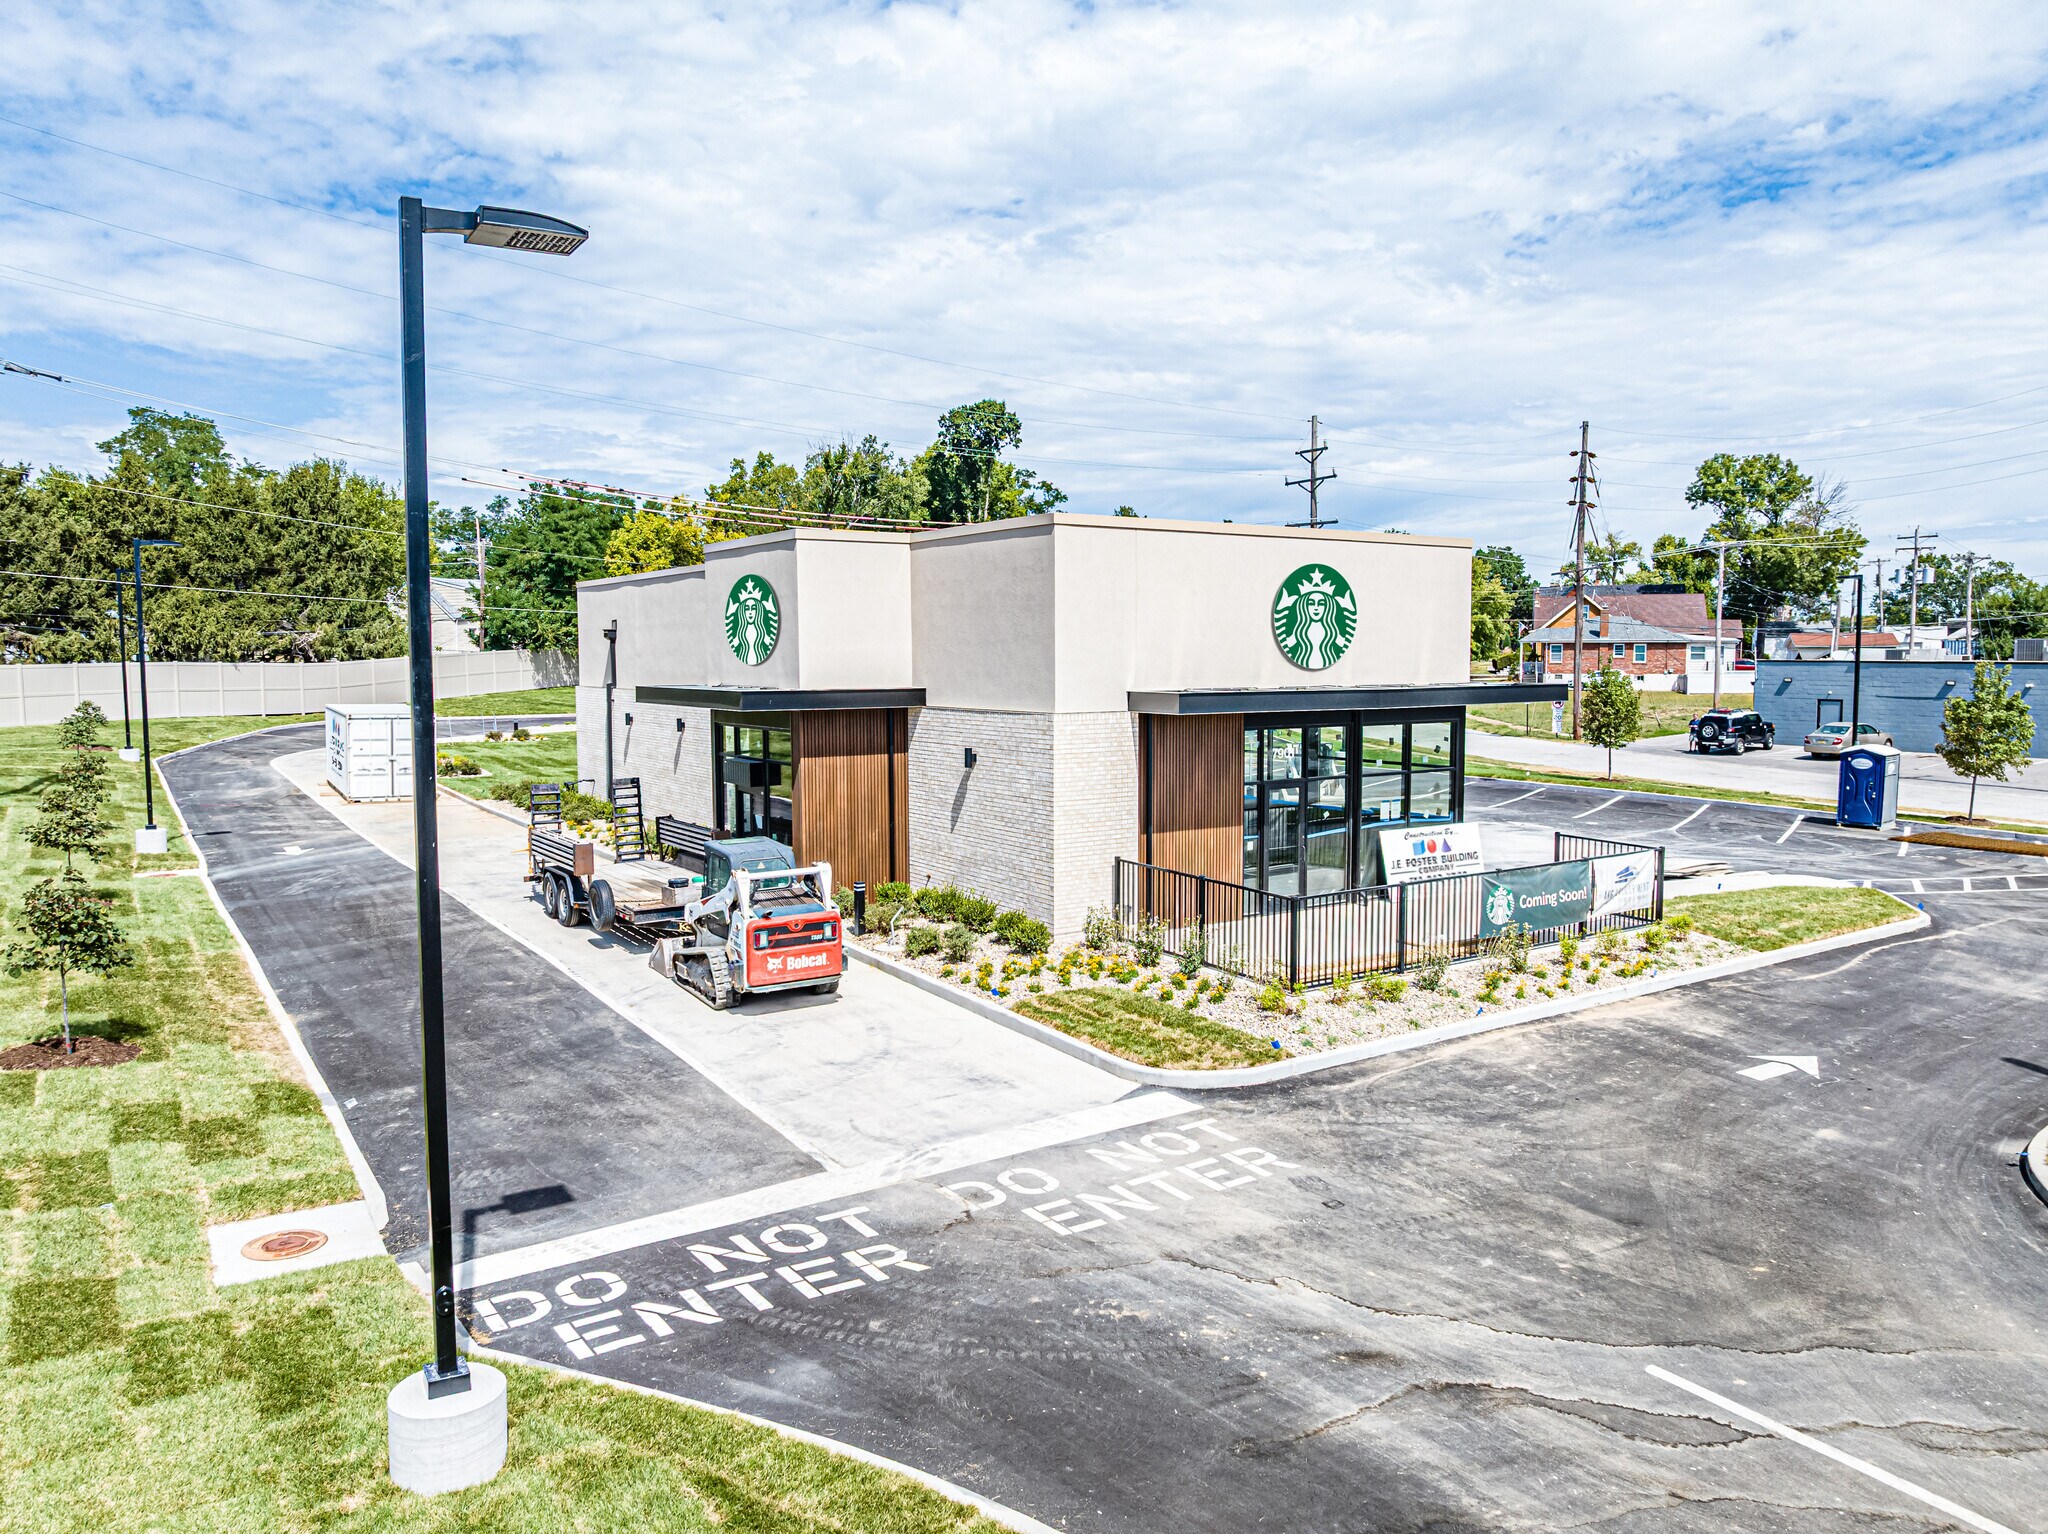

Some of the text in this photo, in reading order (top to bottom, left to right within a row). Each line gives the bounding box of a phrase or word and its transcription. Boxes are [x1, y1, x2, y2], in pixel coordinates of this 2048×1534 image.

[1404, 829, 1443, 840] Construction
[1406, 856, 1438, 867] FOSTER
[1441, 851, 1479, 863] BUILDING
[1418, 863, 1455, 874] COMPANY
[1519, 891, 1558, 909] Coming
[1558, 886, 1588, 903] Soon!
[786, 952, 828, 970] Bobcat
[937, 1117, 1239, 1211] DO NOT
[1021, 1147, 1302, 1236] ENTER
[473, 1206, 879, 1333] DO NOT
[553, 1243, 931, 1360] ENTER
